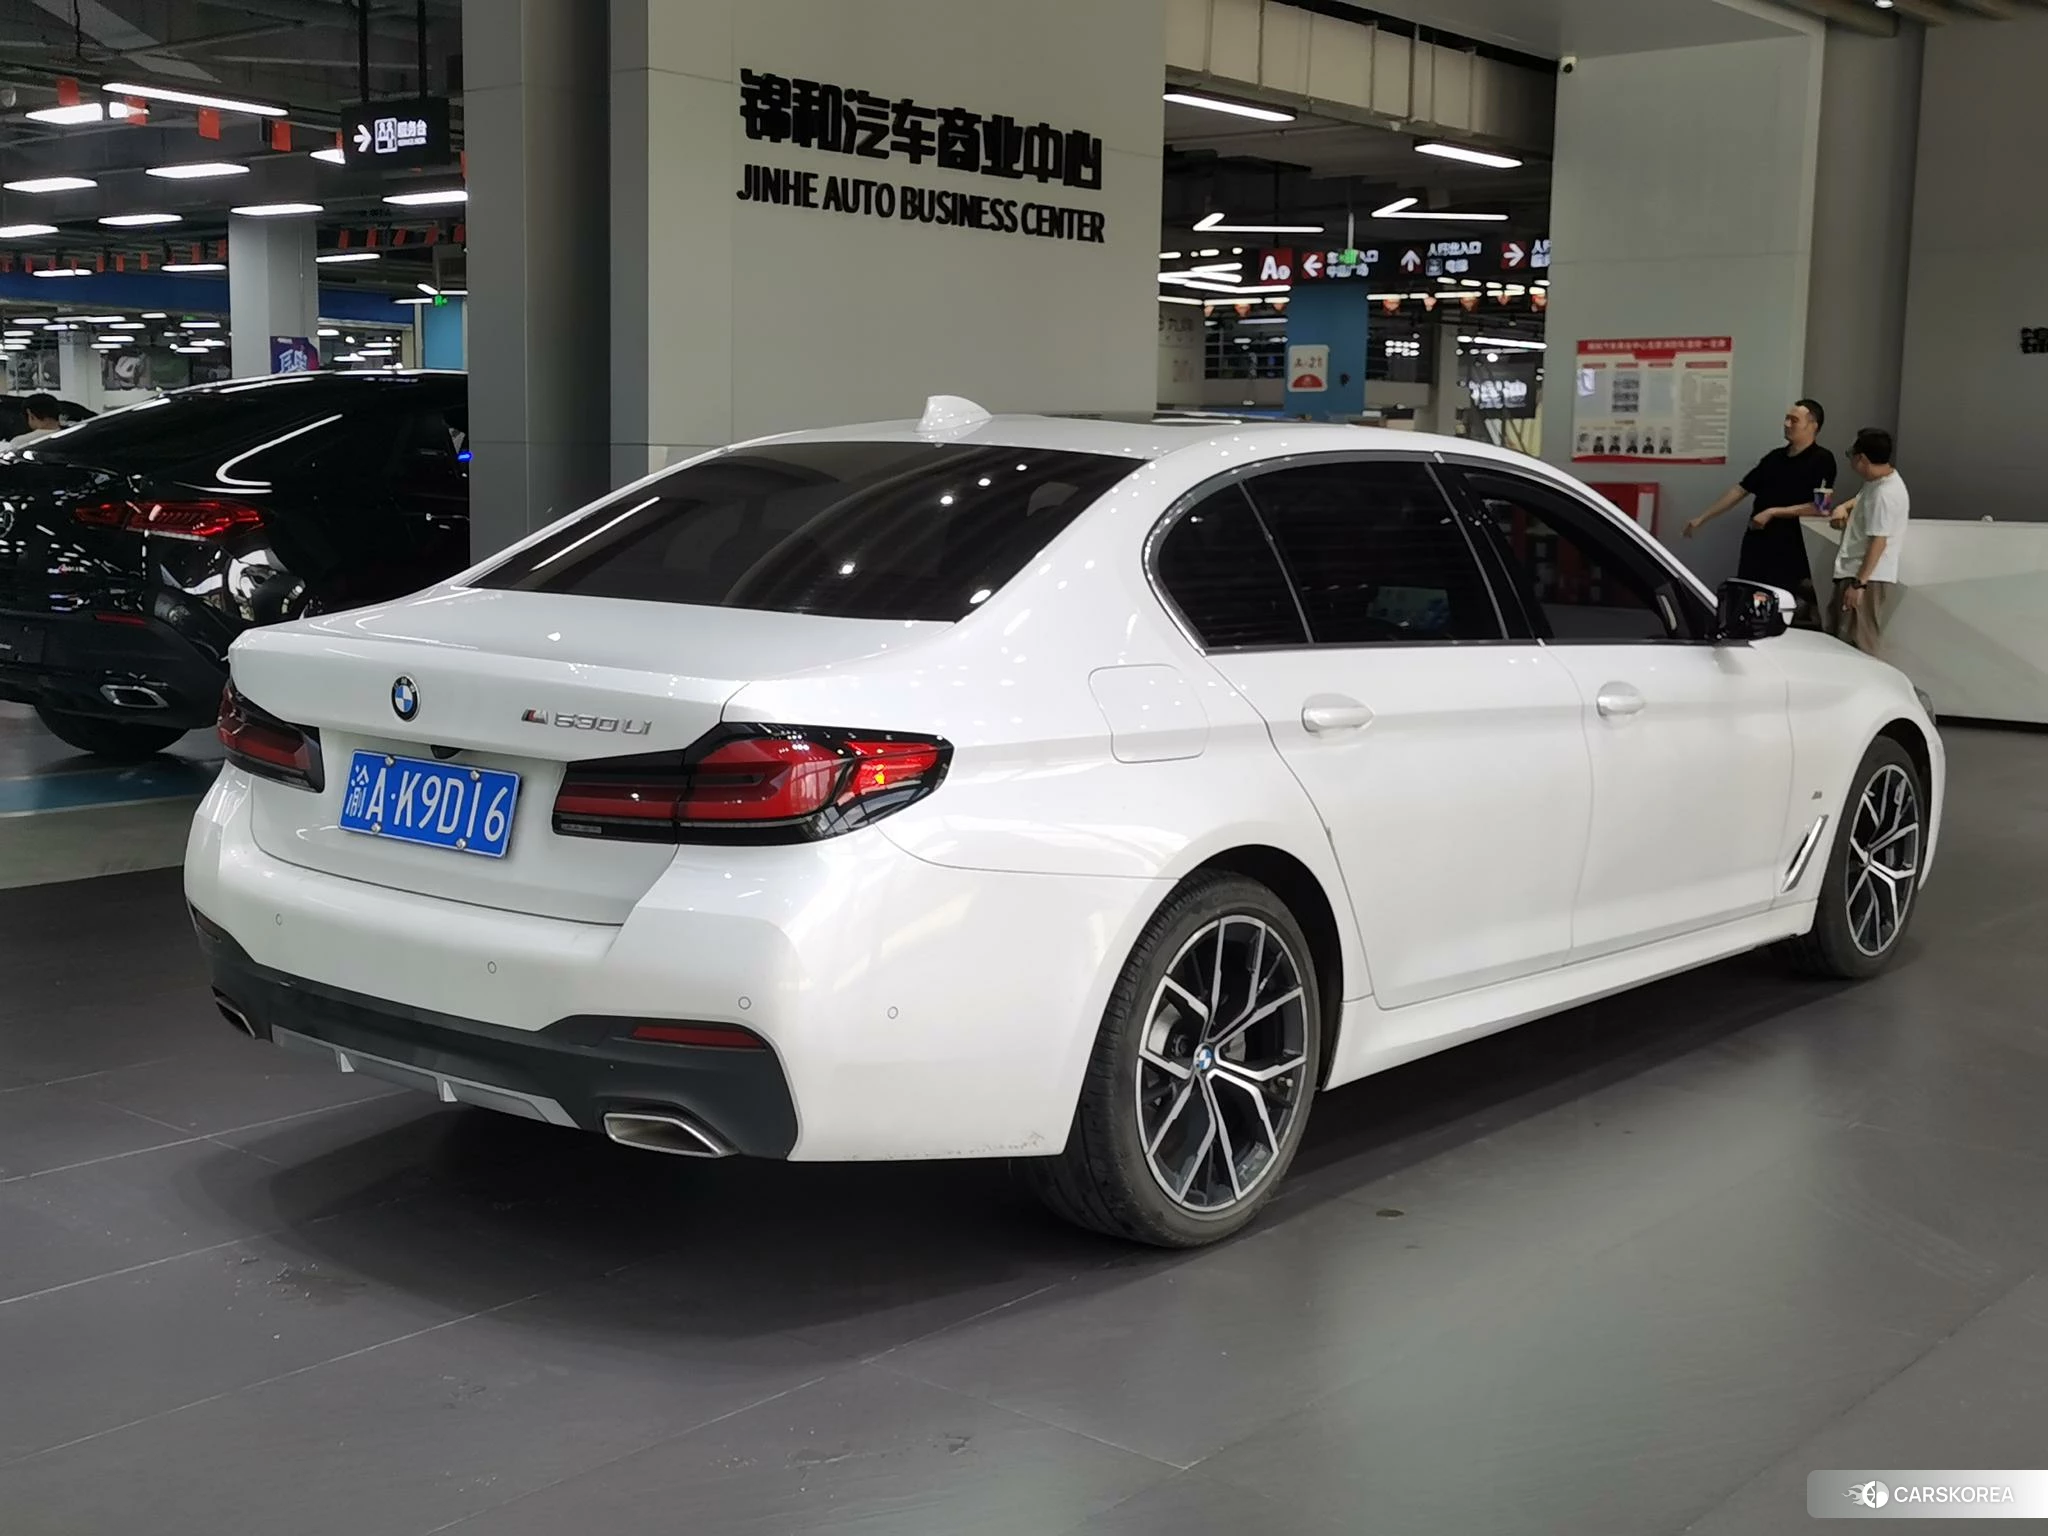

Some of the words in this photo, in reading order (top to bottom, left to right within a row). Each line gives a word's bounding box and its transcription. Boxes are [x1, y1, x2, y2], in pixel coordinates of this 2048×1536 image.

[740, 68, 1102, 190] 锦和汽车商业中心
[737, 164, 818, 208] JINHE
[823, 175, 895, 217] AUTO
[900, 187, 1017, 233] BUSINESS
[1022, 203, 1105, 243] CENTER
